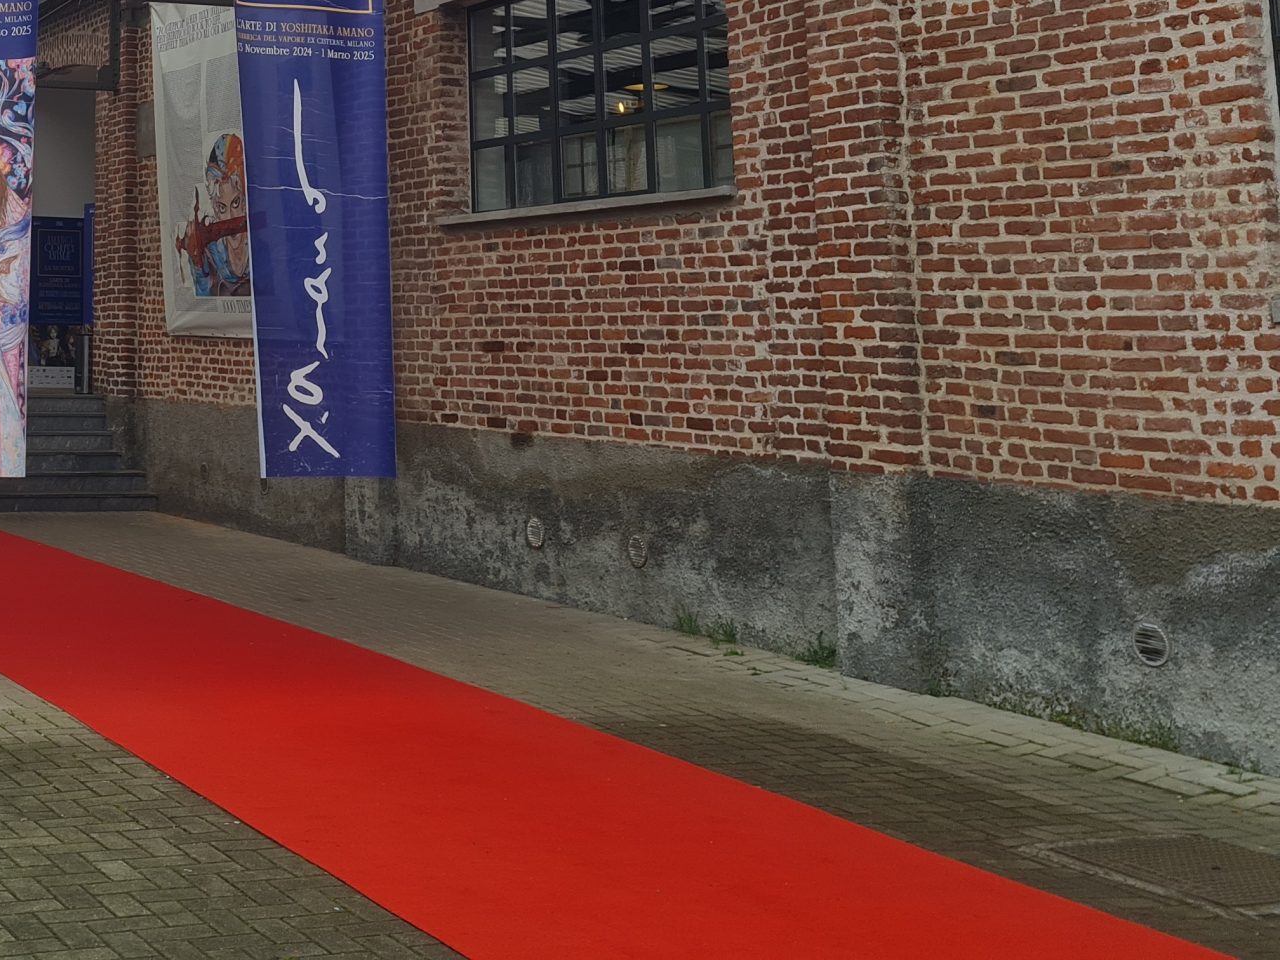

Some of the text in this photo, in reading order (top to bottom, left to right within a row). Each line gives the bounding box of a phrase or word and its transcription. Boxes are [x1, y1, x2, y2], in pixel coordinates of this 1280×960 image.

[5, 15, 33, 23] MILANO
[11, 25, 32, 36] 2025
[266, 22, 277, 32] DI
[281, 22, 334, 36] YOSHITAKA
[337, 26, 374, 38] AMANO
[263, 33, 277, 41] DEL
[279, 35, 305, 43] VAPORE
[347, 40, 375, 48] MILANO
[245, 43, 290, 56] Novembre
[293, 46, 312, 57] 2024
[327, 49, 351, 60] Marzo
[353, 50, 375, 60] 2025
